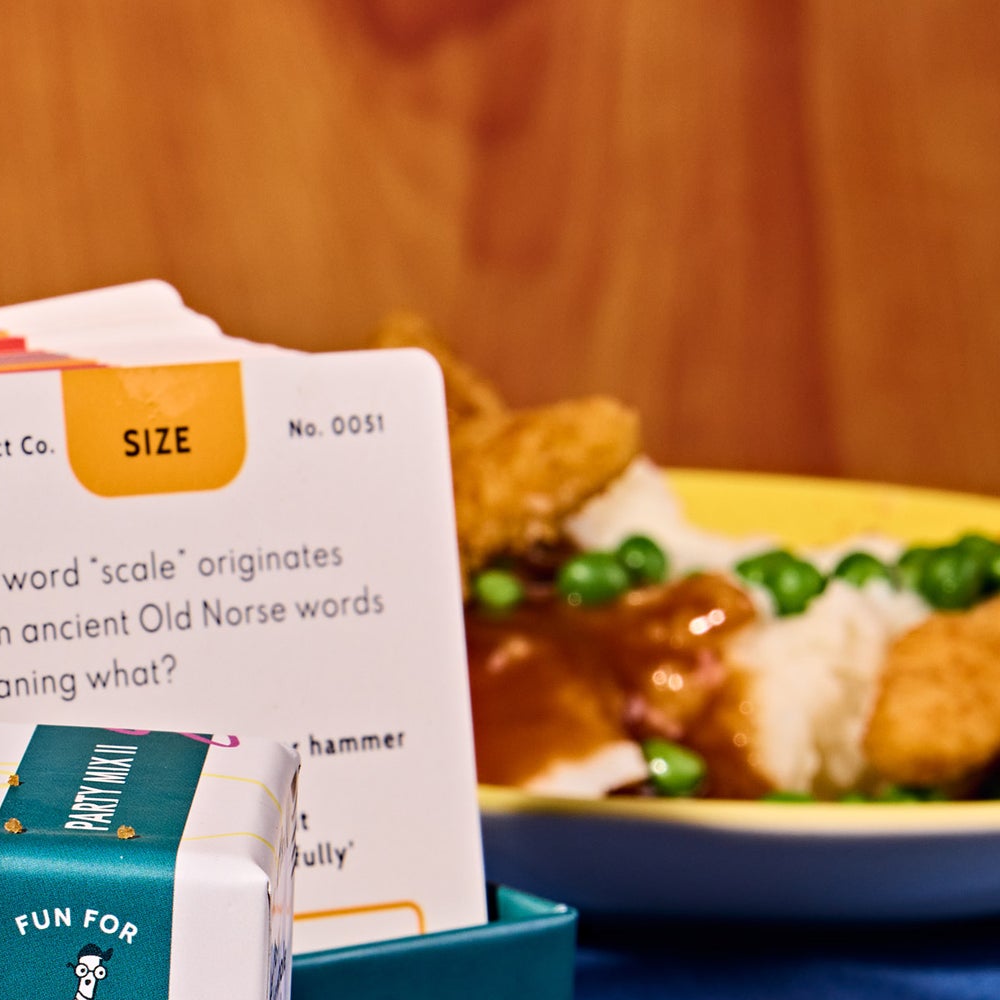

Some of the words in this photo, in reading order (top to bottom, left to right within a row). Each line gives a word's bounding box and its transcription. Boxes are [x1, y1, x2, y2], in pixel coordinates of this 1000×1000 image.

[123, 426, 192, 458] SIZE
[289, 418, 323, 439] No.
[331, 413, 386, 435] 0051
[21, 435, 55, 457] Co.
[3, 556, 80, 592] word
[198, 543, 343, 583] originates
[22, 608, 129, 645] ancient
[139, 602, 192, 634] Old
[203, 598, 286, 629] Norse
[295, 586, 385, 620] words
[86, 653, 178, 690] what?
[94, 744, 138, 754] II
[309, 731, 405, 757] hammer
[83, 756, 134, 784] MIX
[64, 785, 122, 831] PARTY
[14, 907, 72, 936] FUN
[83, 908, 139, 945] FOR
